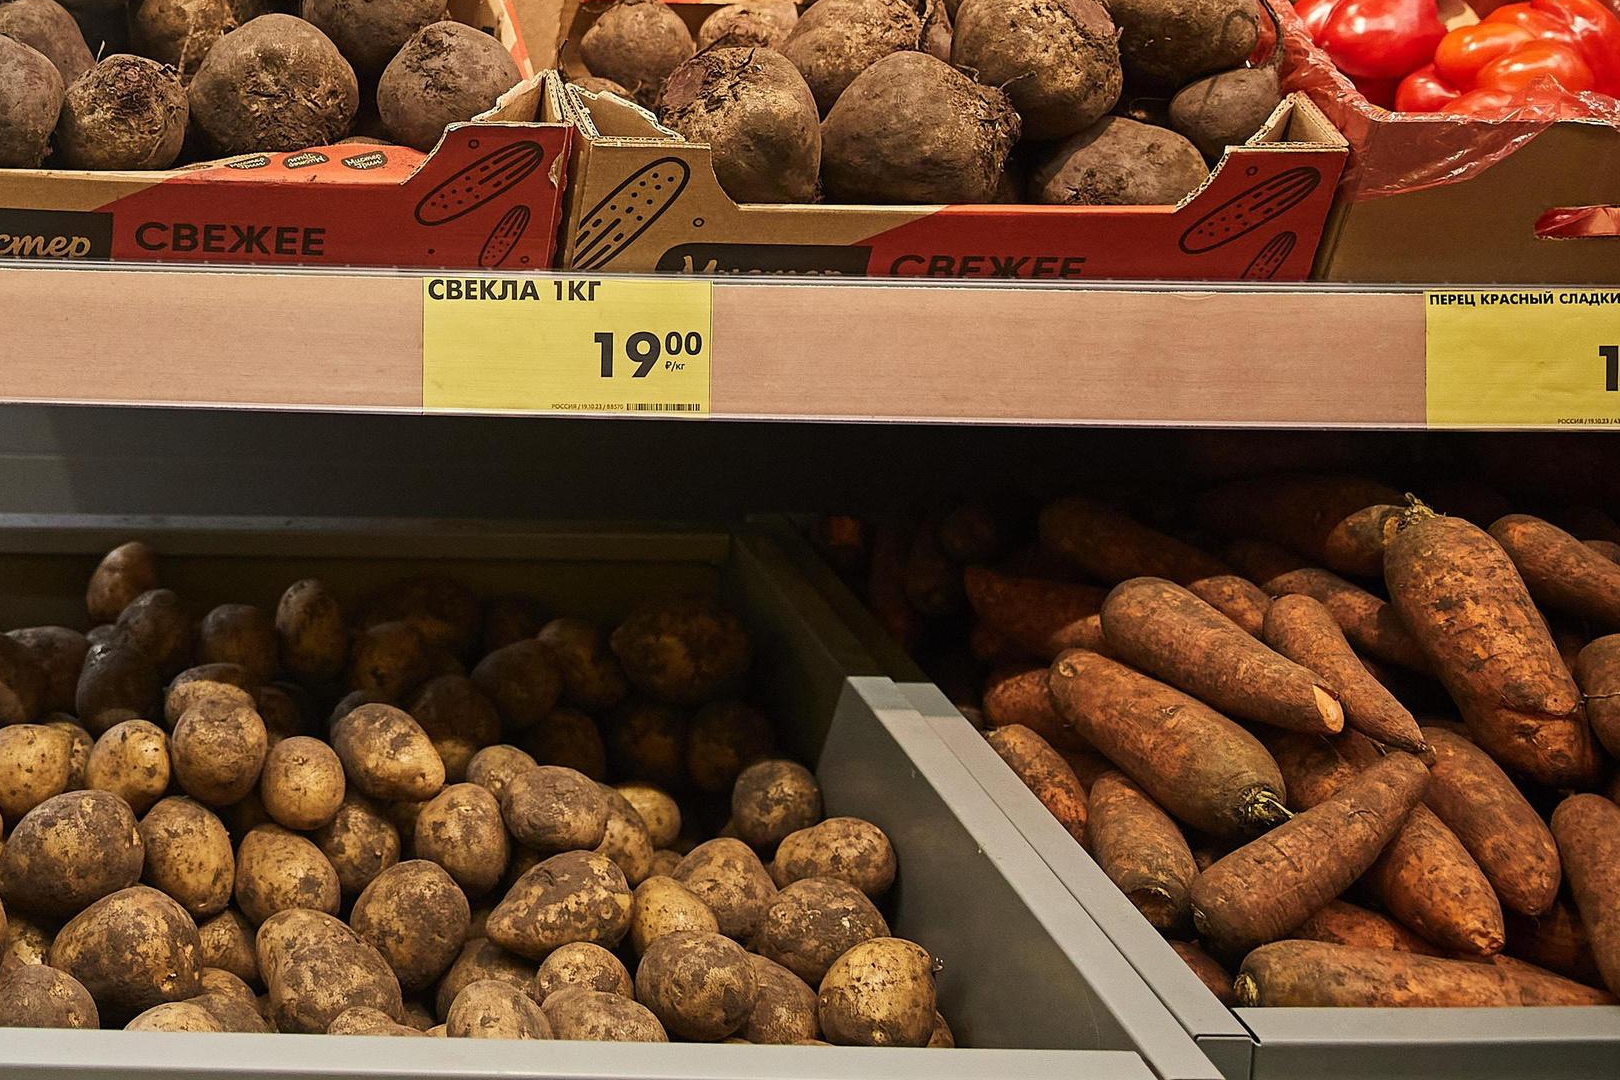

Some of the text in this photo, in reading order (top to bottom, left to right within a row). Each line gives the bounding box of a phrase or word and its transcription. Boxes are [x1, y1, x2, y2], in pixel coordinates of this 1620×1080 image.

[345, 153, 382, 166] Мистер
[135, 221, 326, 256] СВЕЖЕЕ
[428, 279, 601, 301] СВЕКЛА 1КГ
[1430, 291, 1620, 306] ПЕРЕЦ КРАСНЫЙ СЛАДКИ
[665, 361, 685, 372] ₽/кг
[1599, 345, 1619, 391] 1
